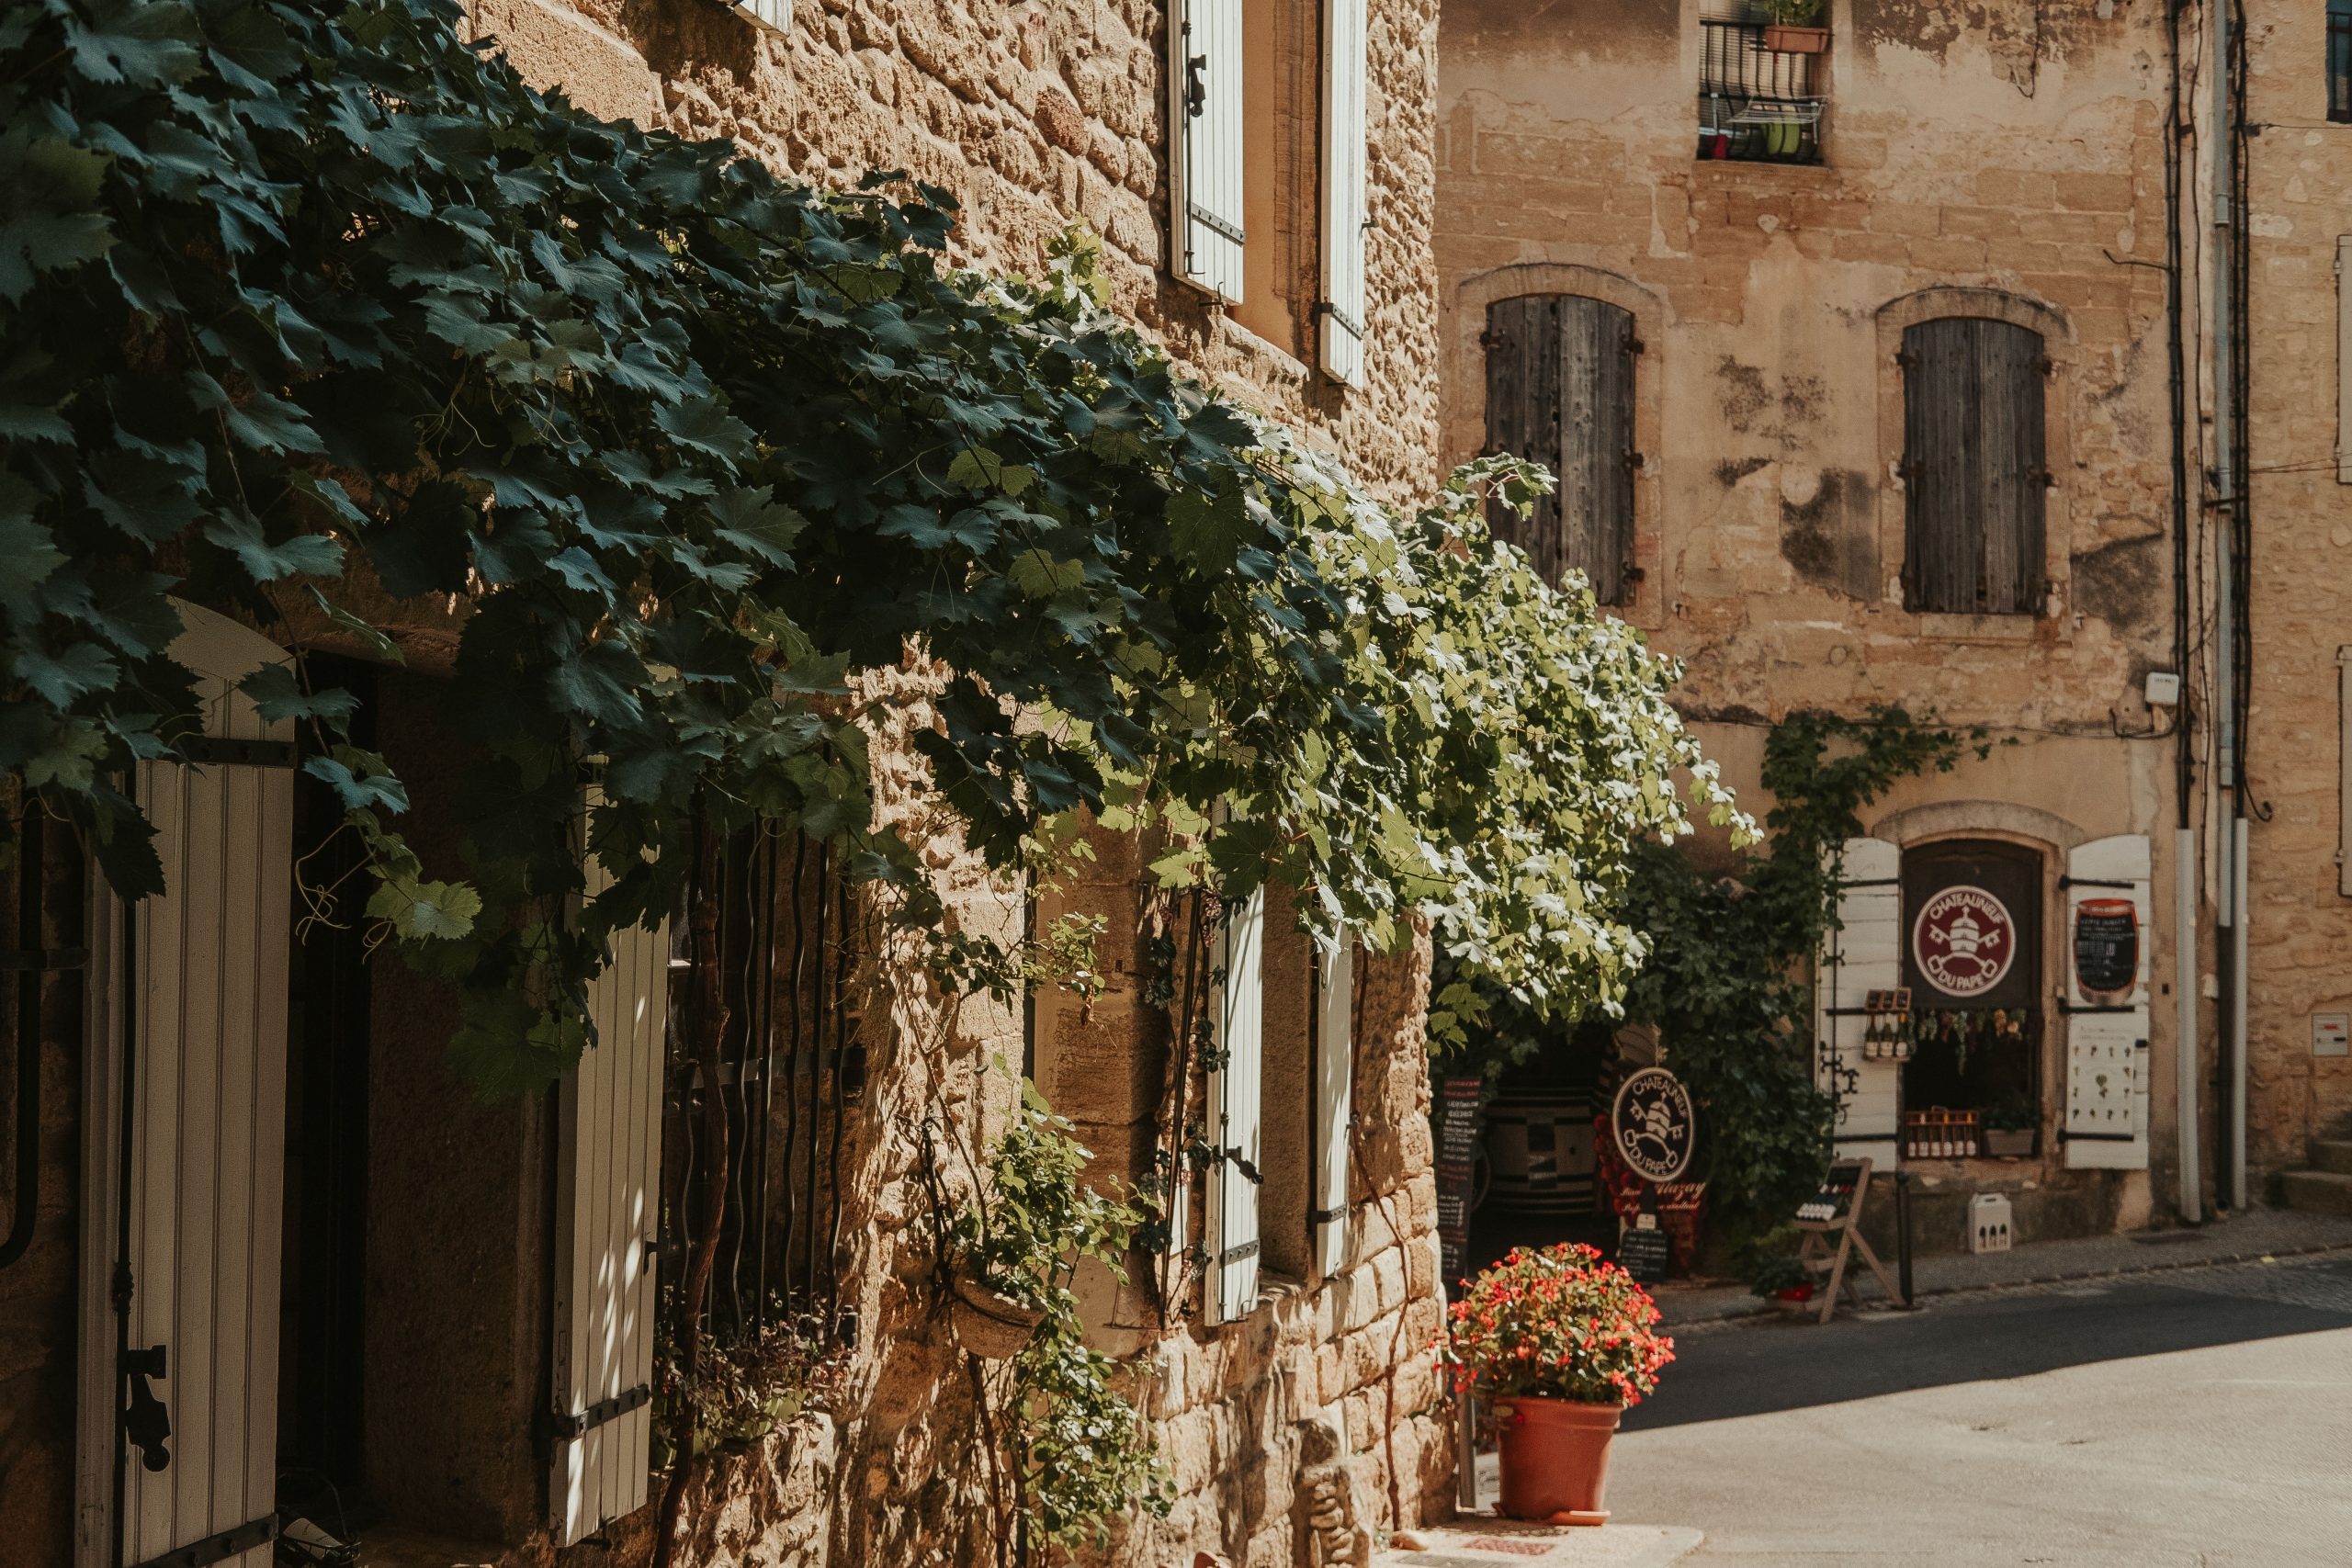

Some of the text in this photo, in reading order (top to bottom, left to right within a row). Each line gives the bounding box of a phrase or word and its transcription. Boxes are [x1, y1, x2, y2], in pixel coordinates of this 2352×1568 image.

[1929, 894, 2004, 924] CHATEAUNEUF
[1938, 969, 1984, 990] DU PAPE
[1632, 1076, 1688, 1118] CHATEAUNEUF
[1630, 1147, 1668, 1175] DU PAPE
